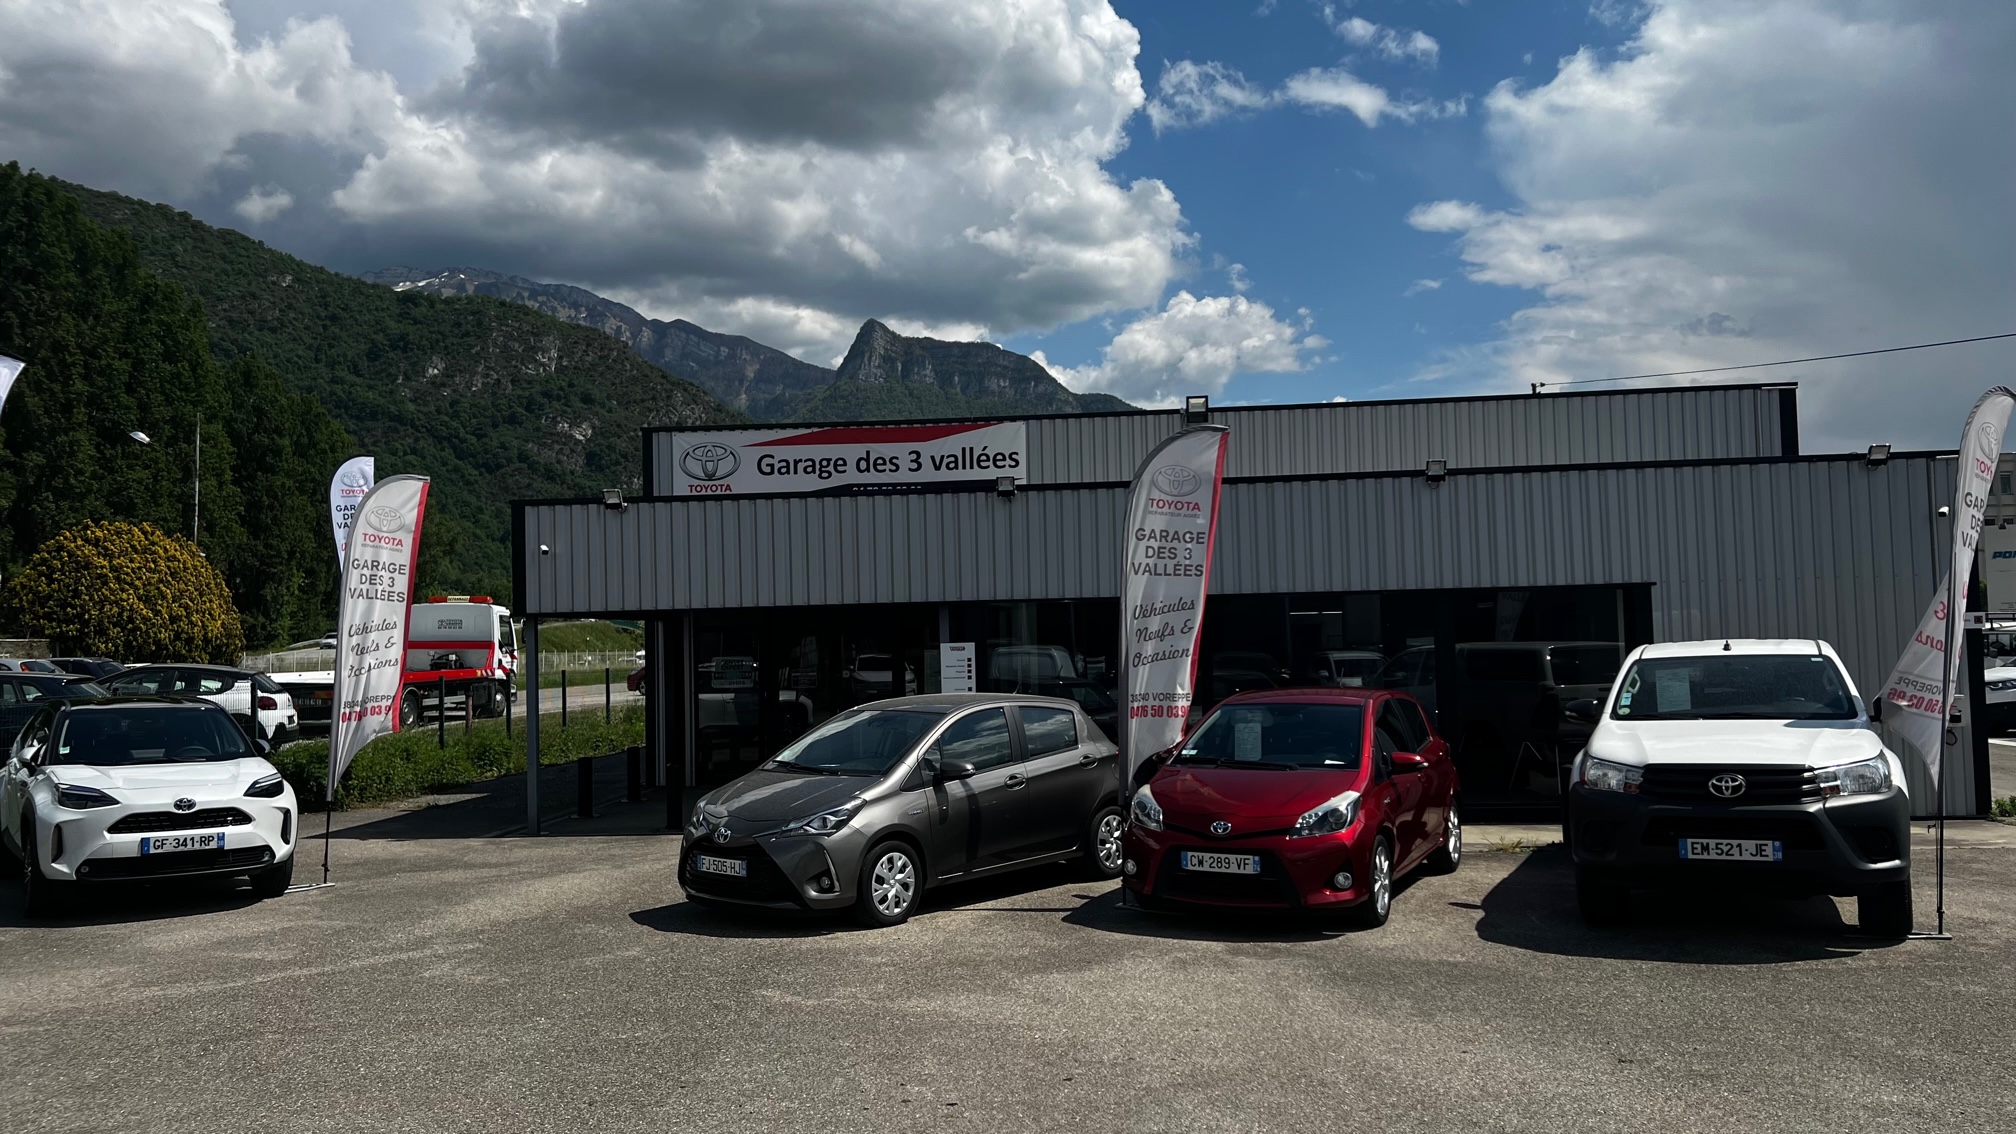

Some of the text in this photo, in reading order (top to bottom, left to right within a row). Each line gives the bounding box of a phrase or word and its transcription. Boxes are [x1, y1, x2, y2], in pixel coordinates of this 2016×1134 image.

[757, 446, 1020, 480] Garage des 3 vallées
[1976, 458, 1993, 478] TOY
[688, 484, 732, 493] TOYOTA
[335, 504, 356, 512] GAR
[1149, 498, 1202, 512] TOYOTA
[362, 532, 404, 548] TOYOTA
[1135, 527, 1206, 544] GARAGE
[1145, 545, 1192, 560] DES 3
[351, 558, 407, 575] GARAGE
[1132, 561, 1204, 577] VALLÉES
[360, 573, 395, 588] DES 3
[349, 587, 406, 603] VALLÉES
[1133, 597, 1195, 620] Véhicules
[1135, 619, 1194, 643] Neufs &
[384, 636, 396, 649] &
[1151, 692, 1192, 702] VOREPPE
[370, 704, 381, 716] 03
[1150, 705, 1164, 718] 50
[153, 835, 215, 850] GF-341-RP
[1690, 842, 1770, 858] EM-521-JE
[701, 857, 741, 875] FJ-505-HJ
[1190, 854, 1251, 871] CW-289-VF
